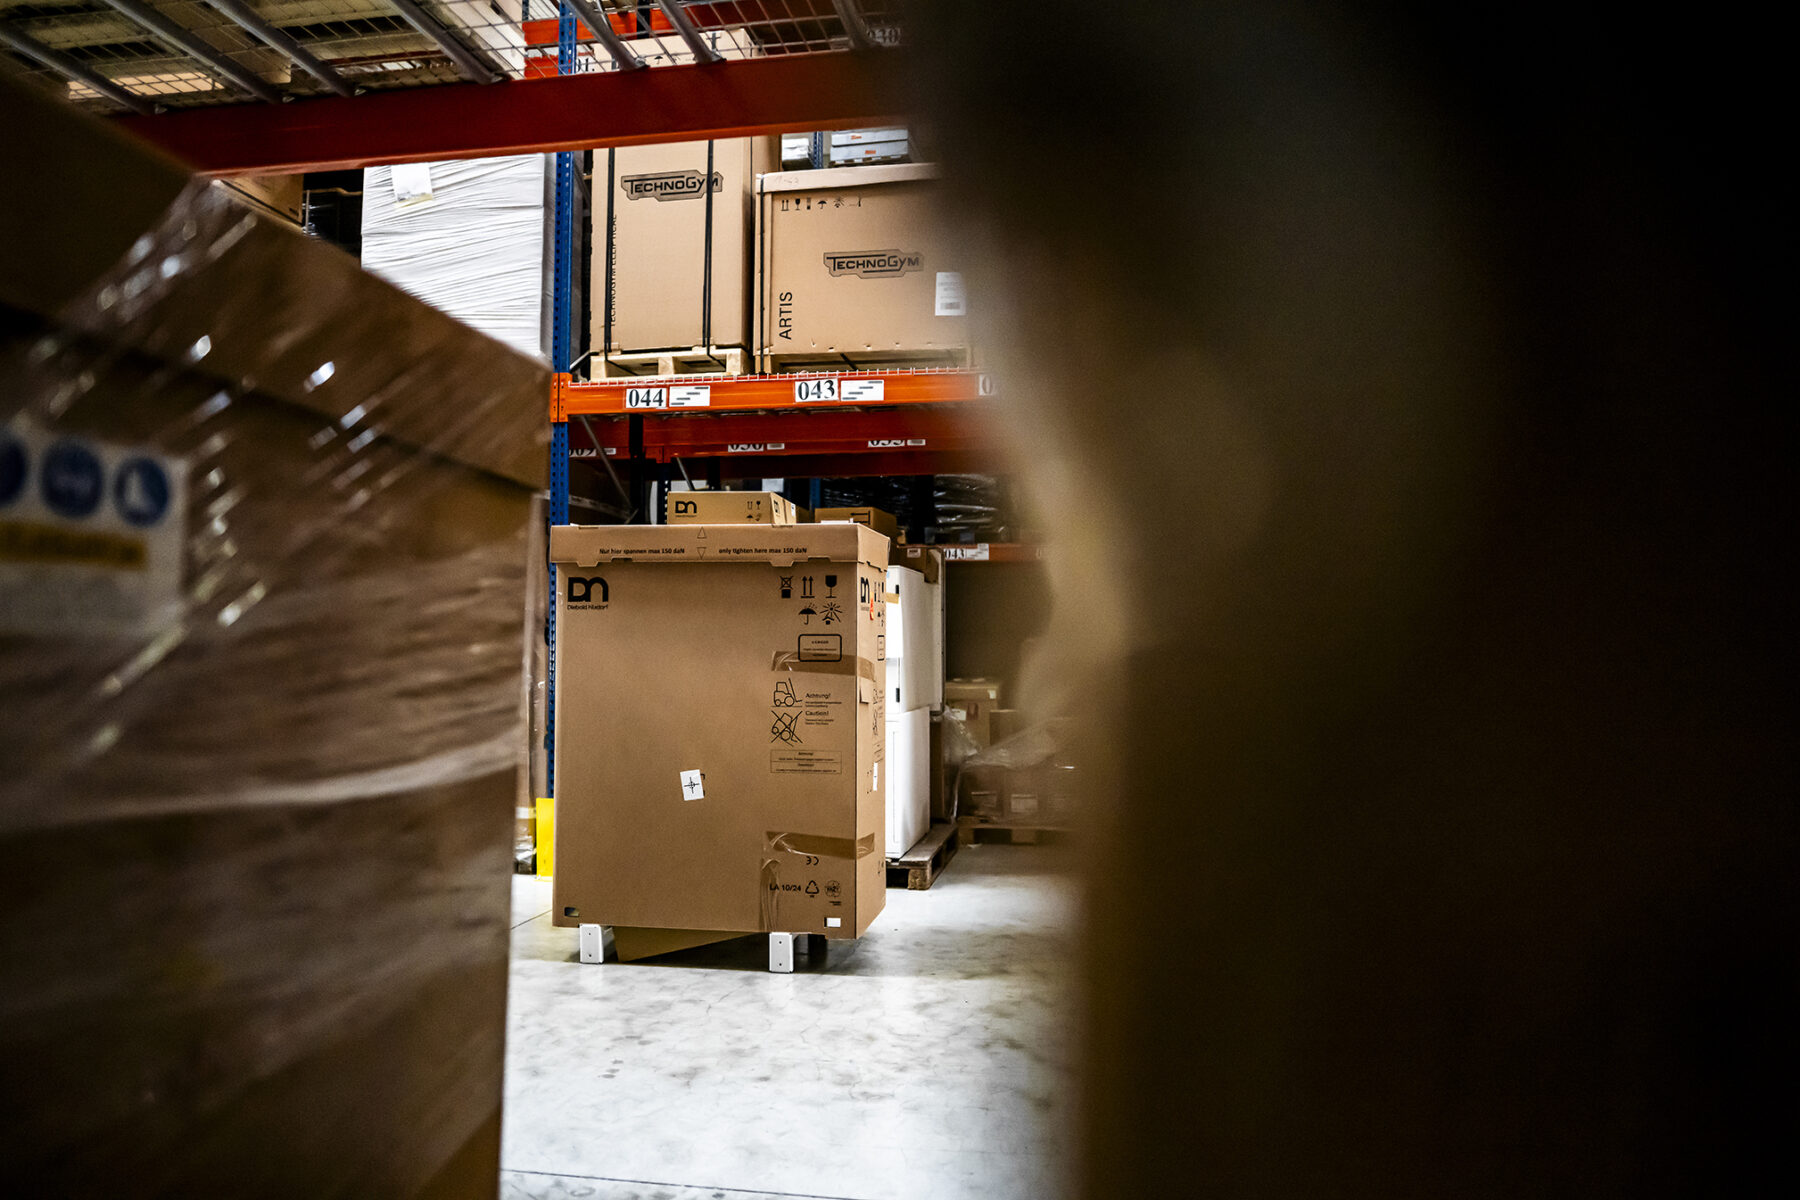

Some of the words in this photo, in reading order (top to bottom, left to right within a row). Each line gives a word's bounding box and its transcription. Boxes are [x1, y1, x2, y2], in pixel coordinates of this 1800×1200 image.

[779, 291, 793, 340] ARTIS
[628, 388, 664, 407] 044
[797, 379, 836, 400] 043
[782, 884, 802, 892] 10/24
